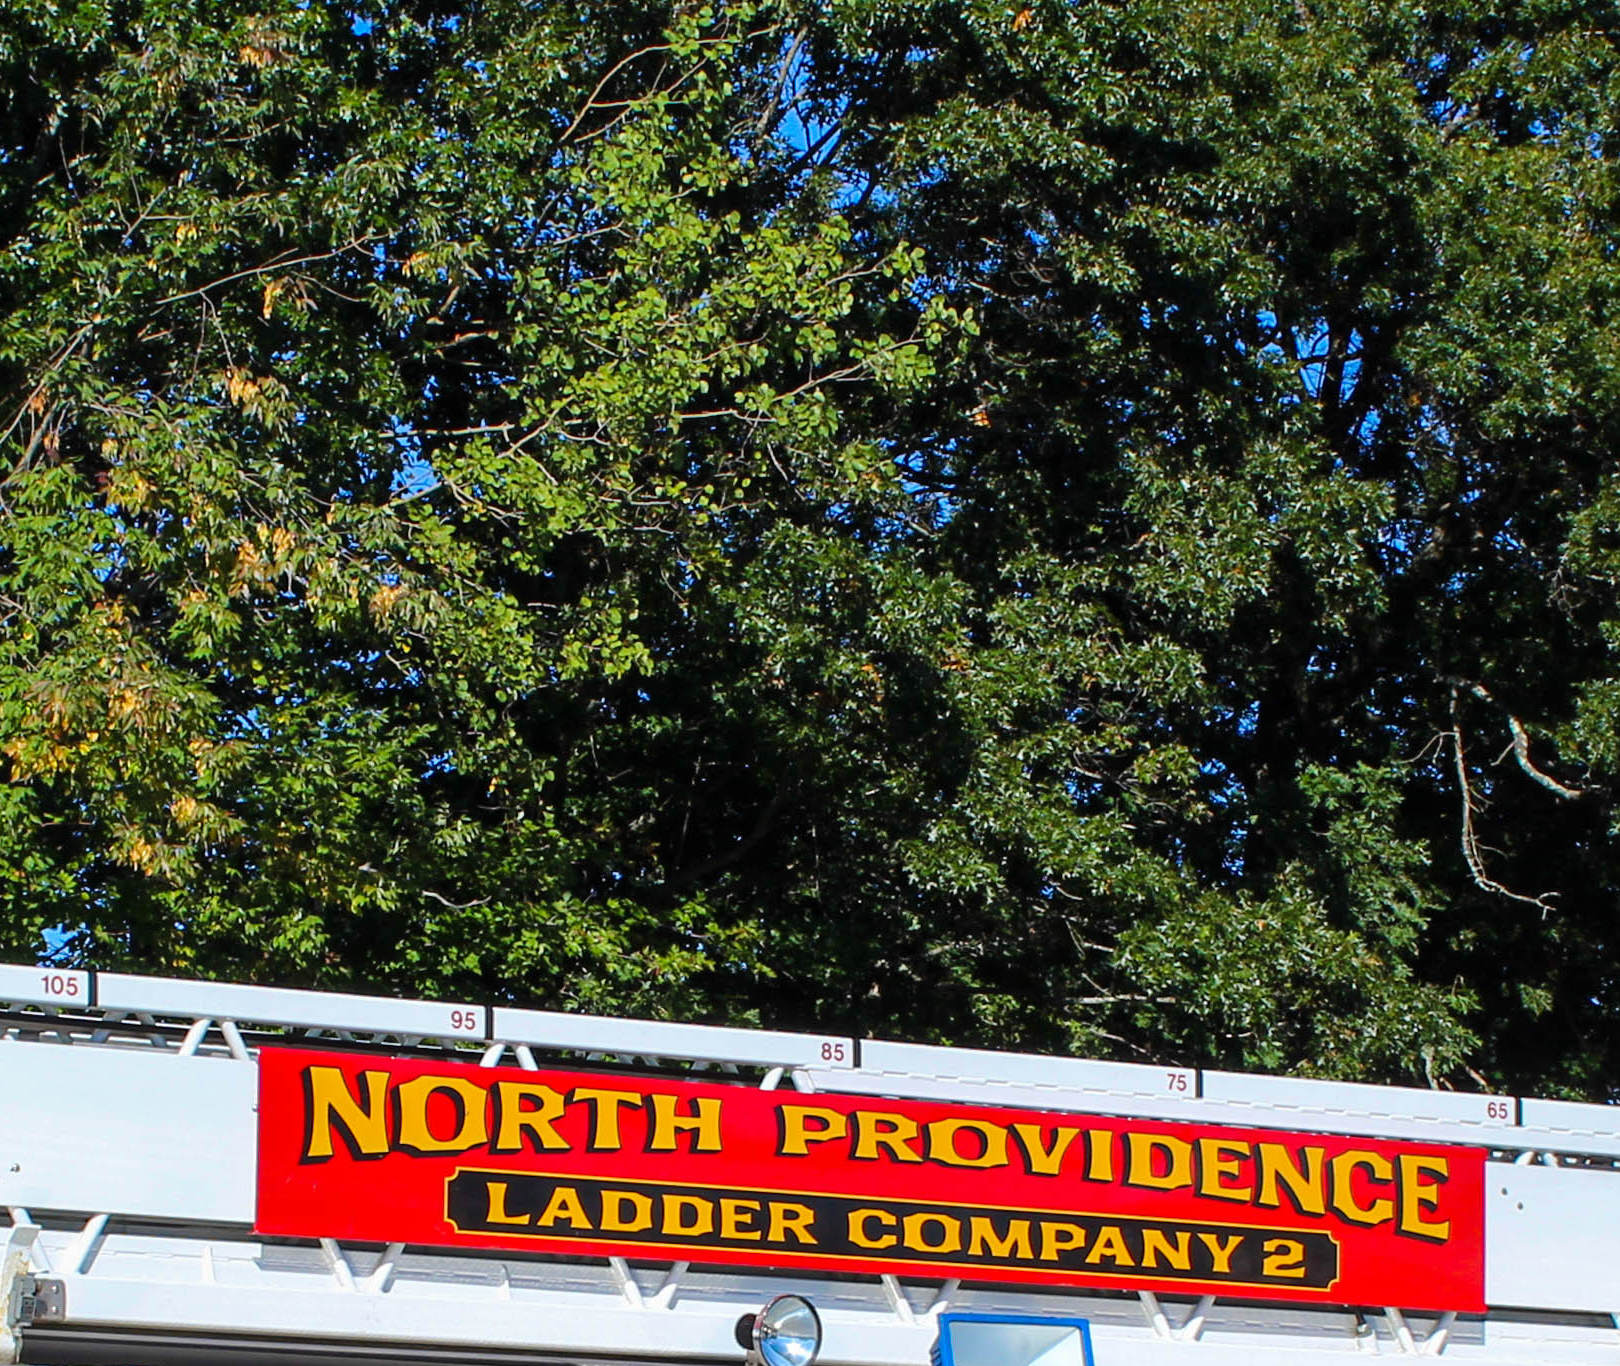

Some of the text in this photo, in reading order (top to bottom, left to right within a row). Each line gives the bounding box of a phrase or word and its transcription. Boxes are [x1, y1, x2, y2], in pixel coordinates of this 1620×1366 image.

[41, 975, 78, 996] 105
[451, 1010, 476, 1030] 95
[821, 1042, 845, 1062] 85
[1166, 1073, 1187, 1092] 75
[1487, 1102, 1508, 1120] 65
[300, 1065, 1450, 1243] NORTH PROVIDENCE
[486, 1181, 1307, 1279] LADDER COMPANY 2
